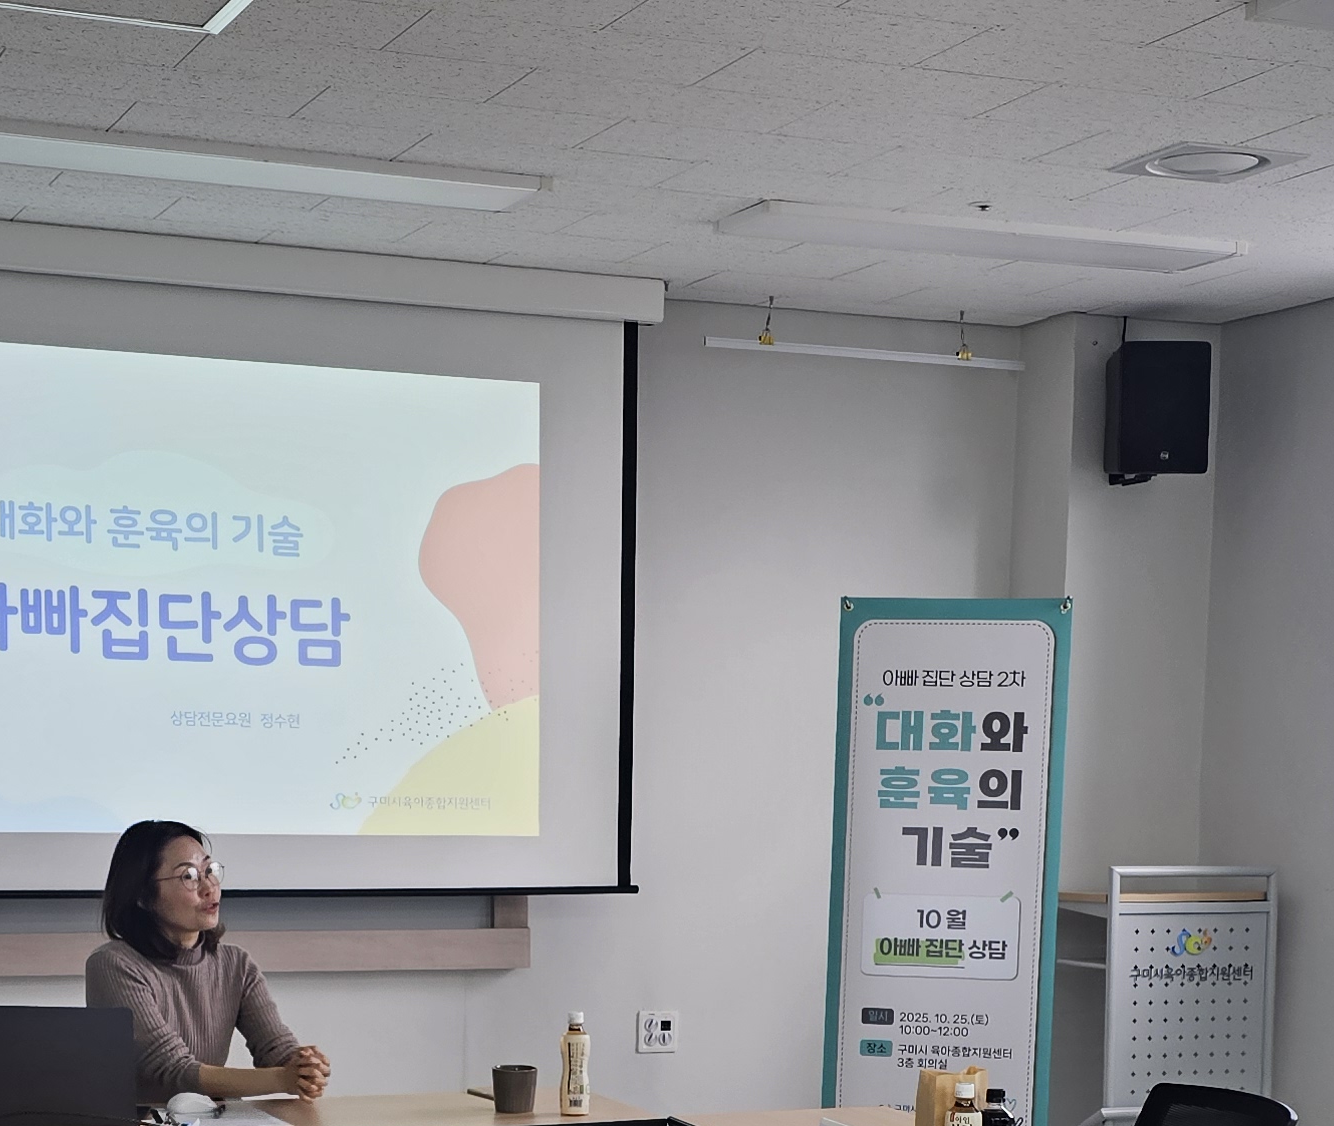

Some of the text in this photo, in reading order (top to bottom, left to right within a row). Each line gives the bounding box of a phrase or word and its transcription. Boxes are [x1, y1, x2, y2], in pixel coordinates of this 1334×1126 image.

[107, 505, 218, 552] 훈육의
[232, 513, 304, 557] 기술
[882, 669, 1026, 688] 아빠 집단 상담 2차
[170, 711, 300, 729] 상담전문요원 정수현
[878, 766, 1023, 810] 훈육의
[368, 796, 492, 810] 구미시육아종합지원센터
[917, 909, 967, 930] 10 월
[879, 937, 1008, 960] 아빠 집단 상담
[1129, 966, 1254, 982] 구미시육아종합지원센터
[868, 1009, 888, 1022] 일시
[899, 1012, 931, 1024] 2025.
[934, 1013, 950, 1024] 10.
[899, 1025, 969, 1037] 10:00~12:00
[866, 1042, 887, 1054] 장소
[897, 1044, 1013, 1060] 구미시 육아종합지원센터
[897, 1058, 948, 1070] 3층 회의실
